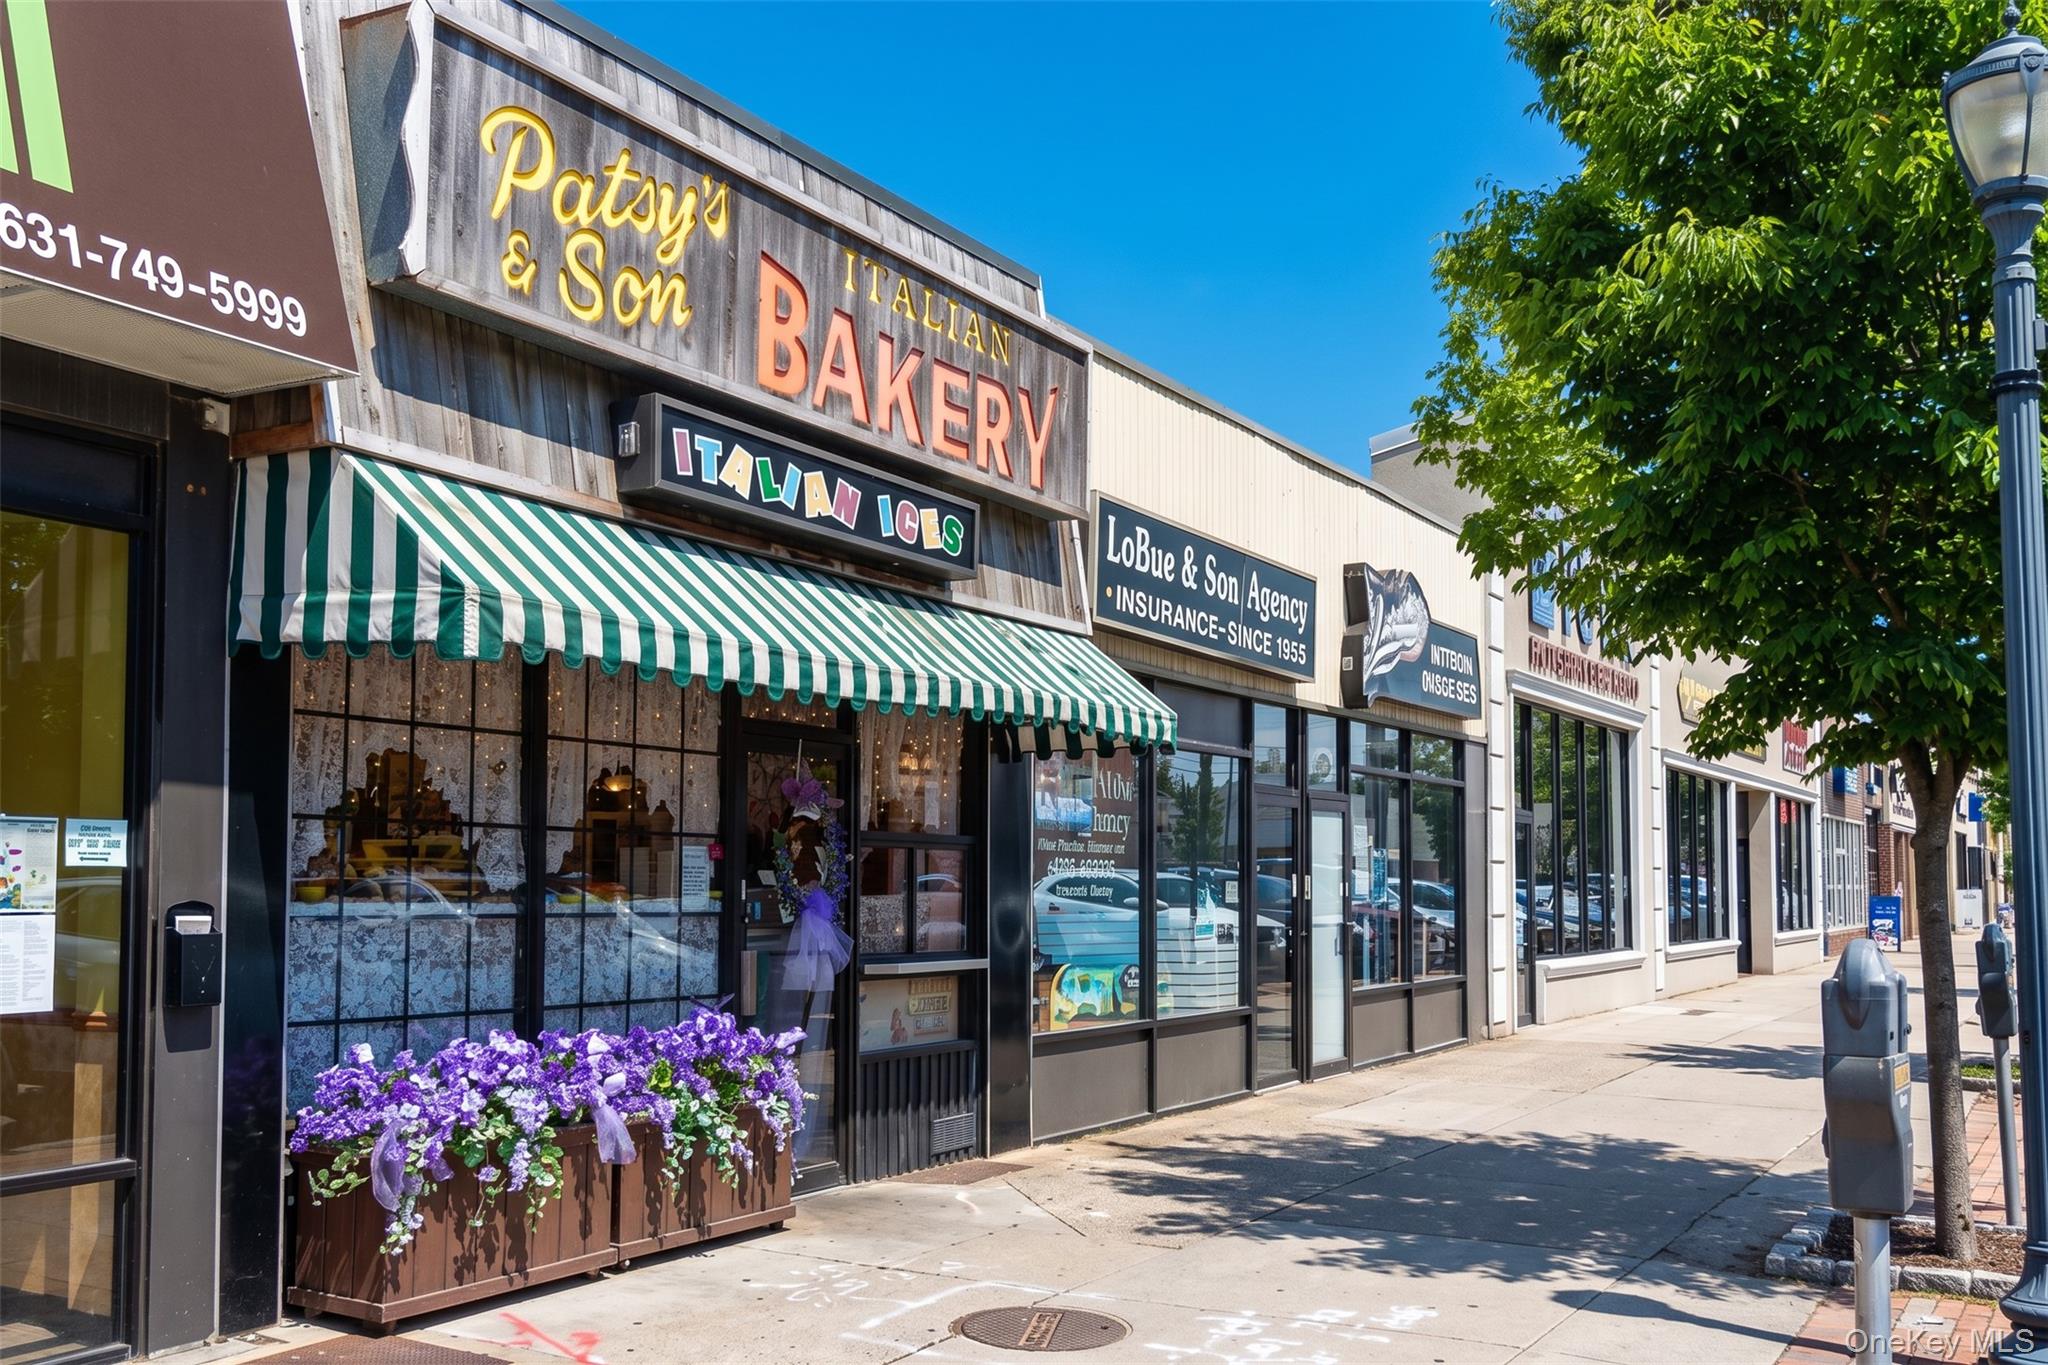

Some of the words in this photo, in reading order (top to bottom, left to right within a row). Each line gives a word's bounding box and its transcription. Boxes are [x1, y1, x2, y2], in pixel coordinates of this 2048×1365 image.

[480, 105, 729, 266] Patsy's
[0, 202, 307, 337] 631-749-5999
[501, 229, 537, 296] &
[559, 227, 693, 327] Son
[843, 248, 1012, 367] ITALIAN
[756, 250, 1059, 493] BAKERY
[672, 427, 862, 530] ITALIAN
[876, 494, 965, 557] ICES
[1106, 514, 1175, 583] LoBue
[1181, 545, 1198, 590] &
[1204, 553, 1239, 605] Son
[1246, 570, 1308, 635] Agency
[1276, 636, 1307, 665] 1955
